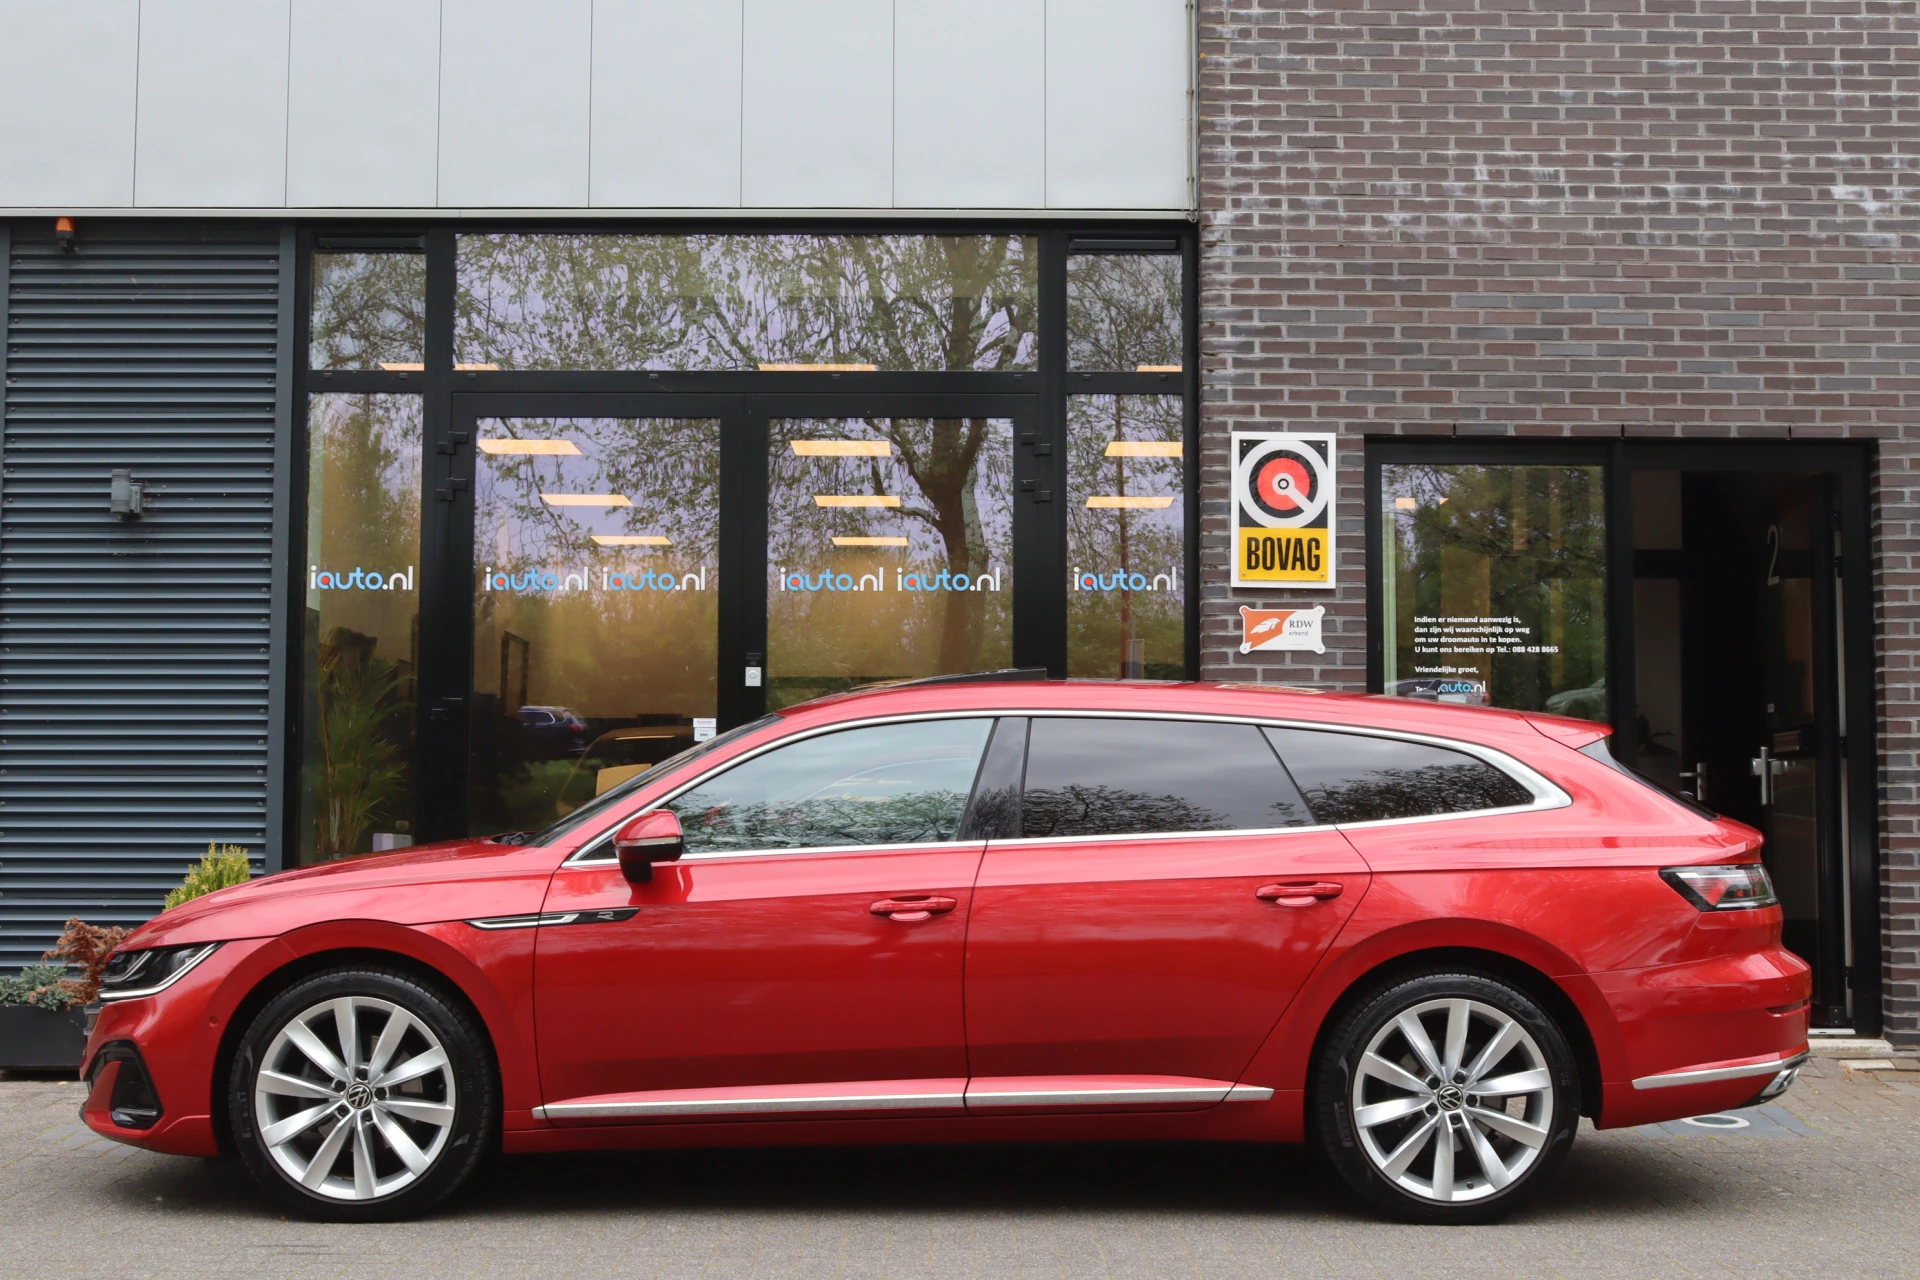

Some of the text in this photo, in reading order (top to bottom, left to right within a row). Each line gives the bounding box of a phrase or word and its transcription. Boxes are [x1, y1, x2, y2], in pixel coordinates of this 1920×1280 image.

[1246, 536, 1321, 572] BOVAG
[1766, 523, 1780, 587] 2
[310, 565, 414, 591] iauto.nl
[485, 566, 706, 591] iauto.nl iauto.nl
[780, 566, 1001, 592] iauto.nl iauto.nl
[1073, 566, 1177, 591] iauto.nl
[1289, 620, 1314, 628] RDW
[1429, 626, 1442, 634] zijn
[1442, 626, 1454, 634] wij
[1455, 626, 1504, 634] waarschijnlijk
[1515, 627, 1530, 635] weg
[1479, 616, 1512, 625] aanwezig
[1513, 616, 1522, 624] is,
[1440, 635, 1480, 643] droomauto
[1497, 636, 1522, 644] kopen.
[1415, 666, 1479, 675] Vriendelijke groet,
